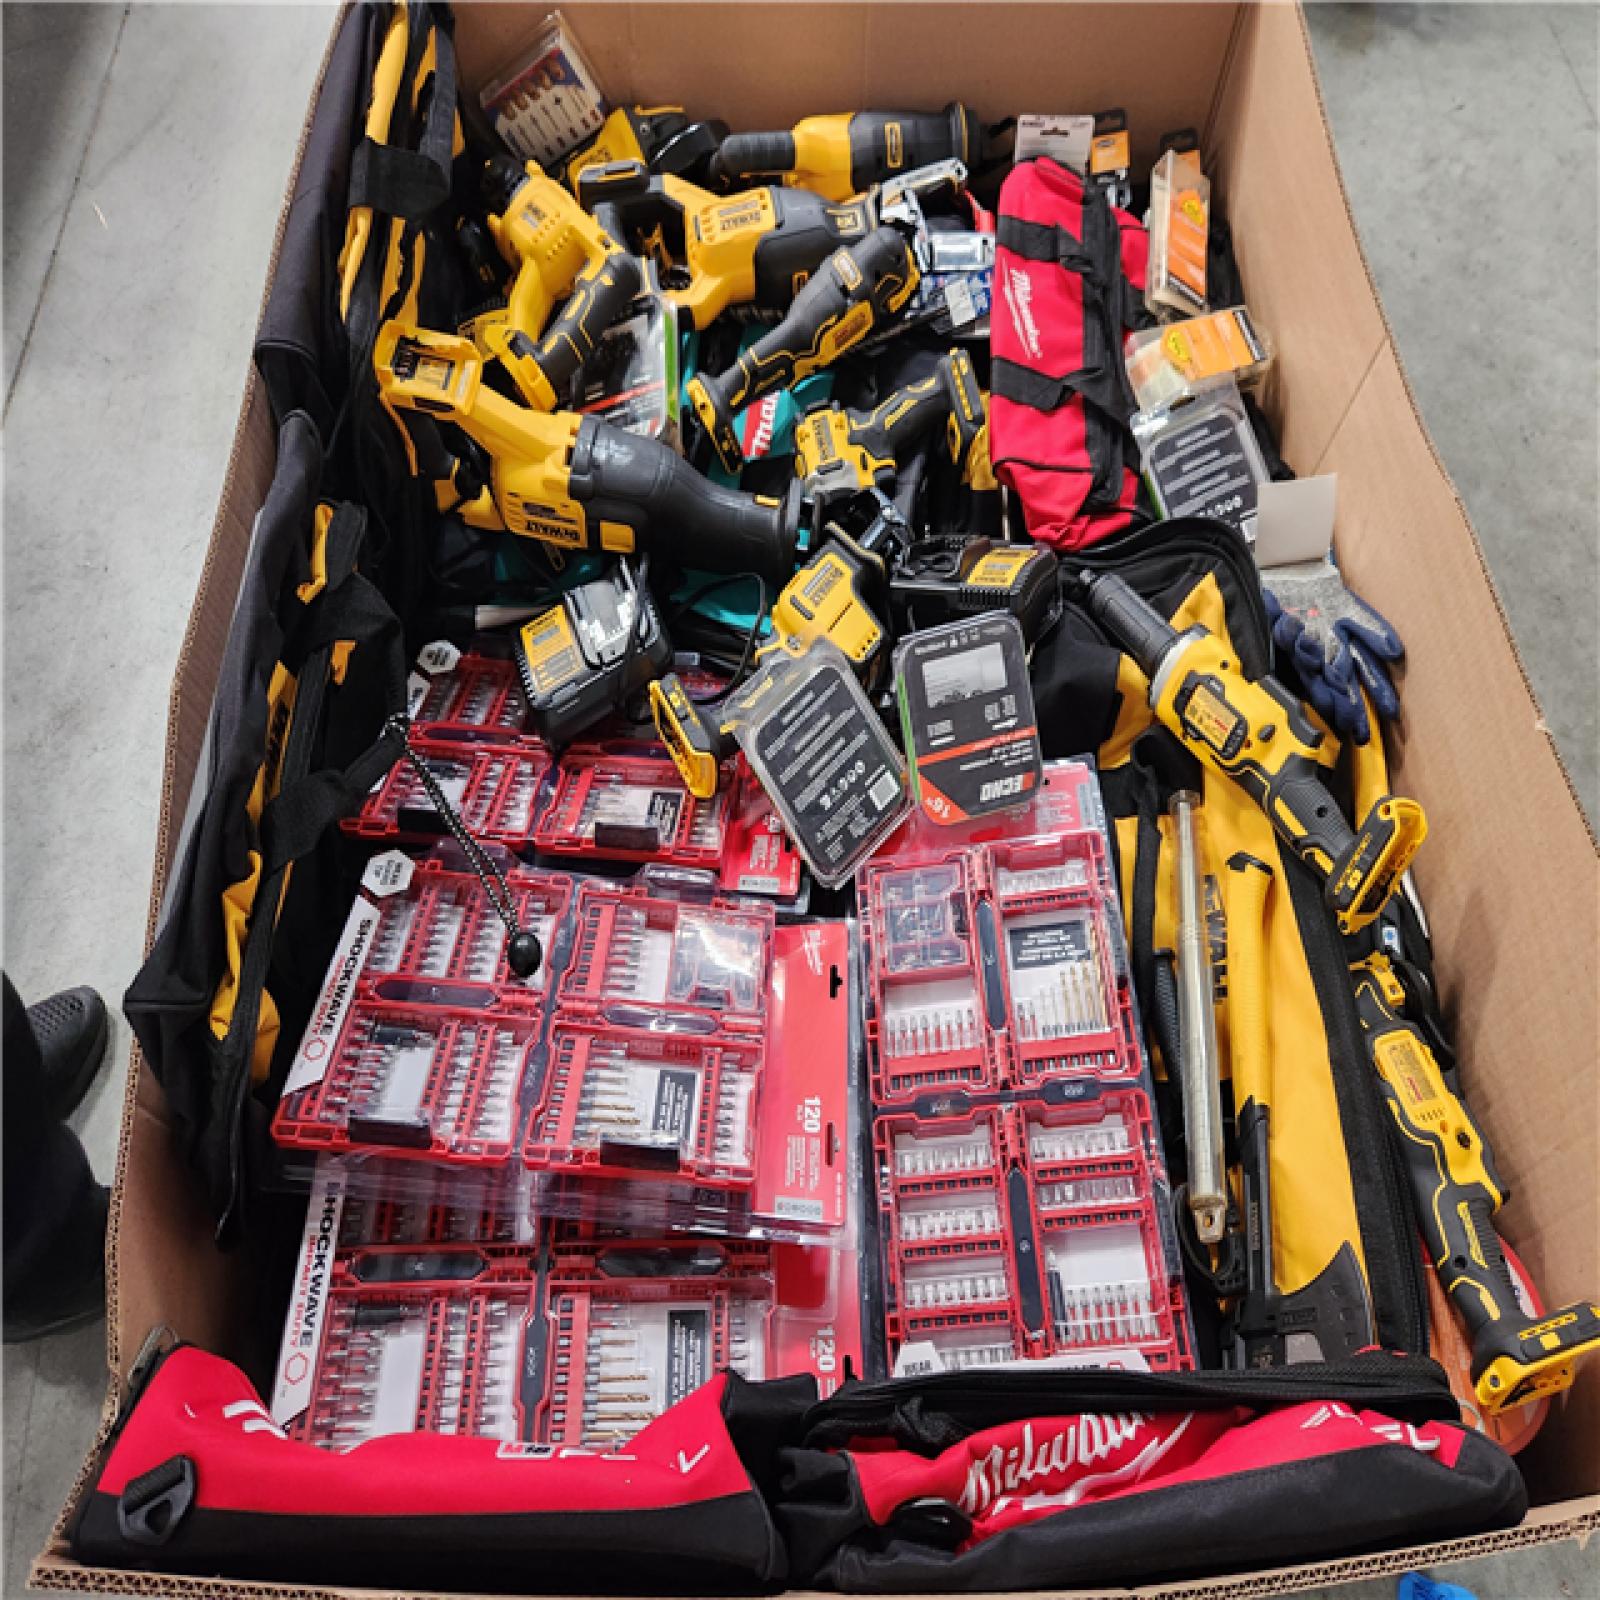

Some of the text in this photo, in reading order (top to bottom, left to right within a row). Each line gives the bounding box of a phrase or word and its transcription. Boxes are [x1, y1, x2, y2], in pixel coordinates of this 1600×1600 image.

[525, 519, 581, 542] DEWALT
[978, 775, 1026, 802] ECHO
[320, 917, 374, 1037] SHOCKWAVE
[802, 1095, 821, 1134] 120
[297, 1182, 344, 1347] SHOCKWAVE
[815, 1326, 837, 1373] 120
